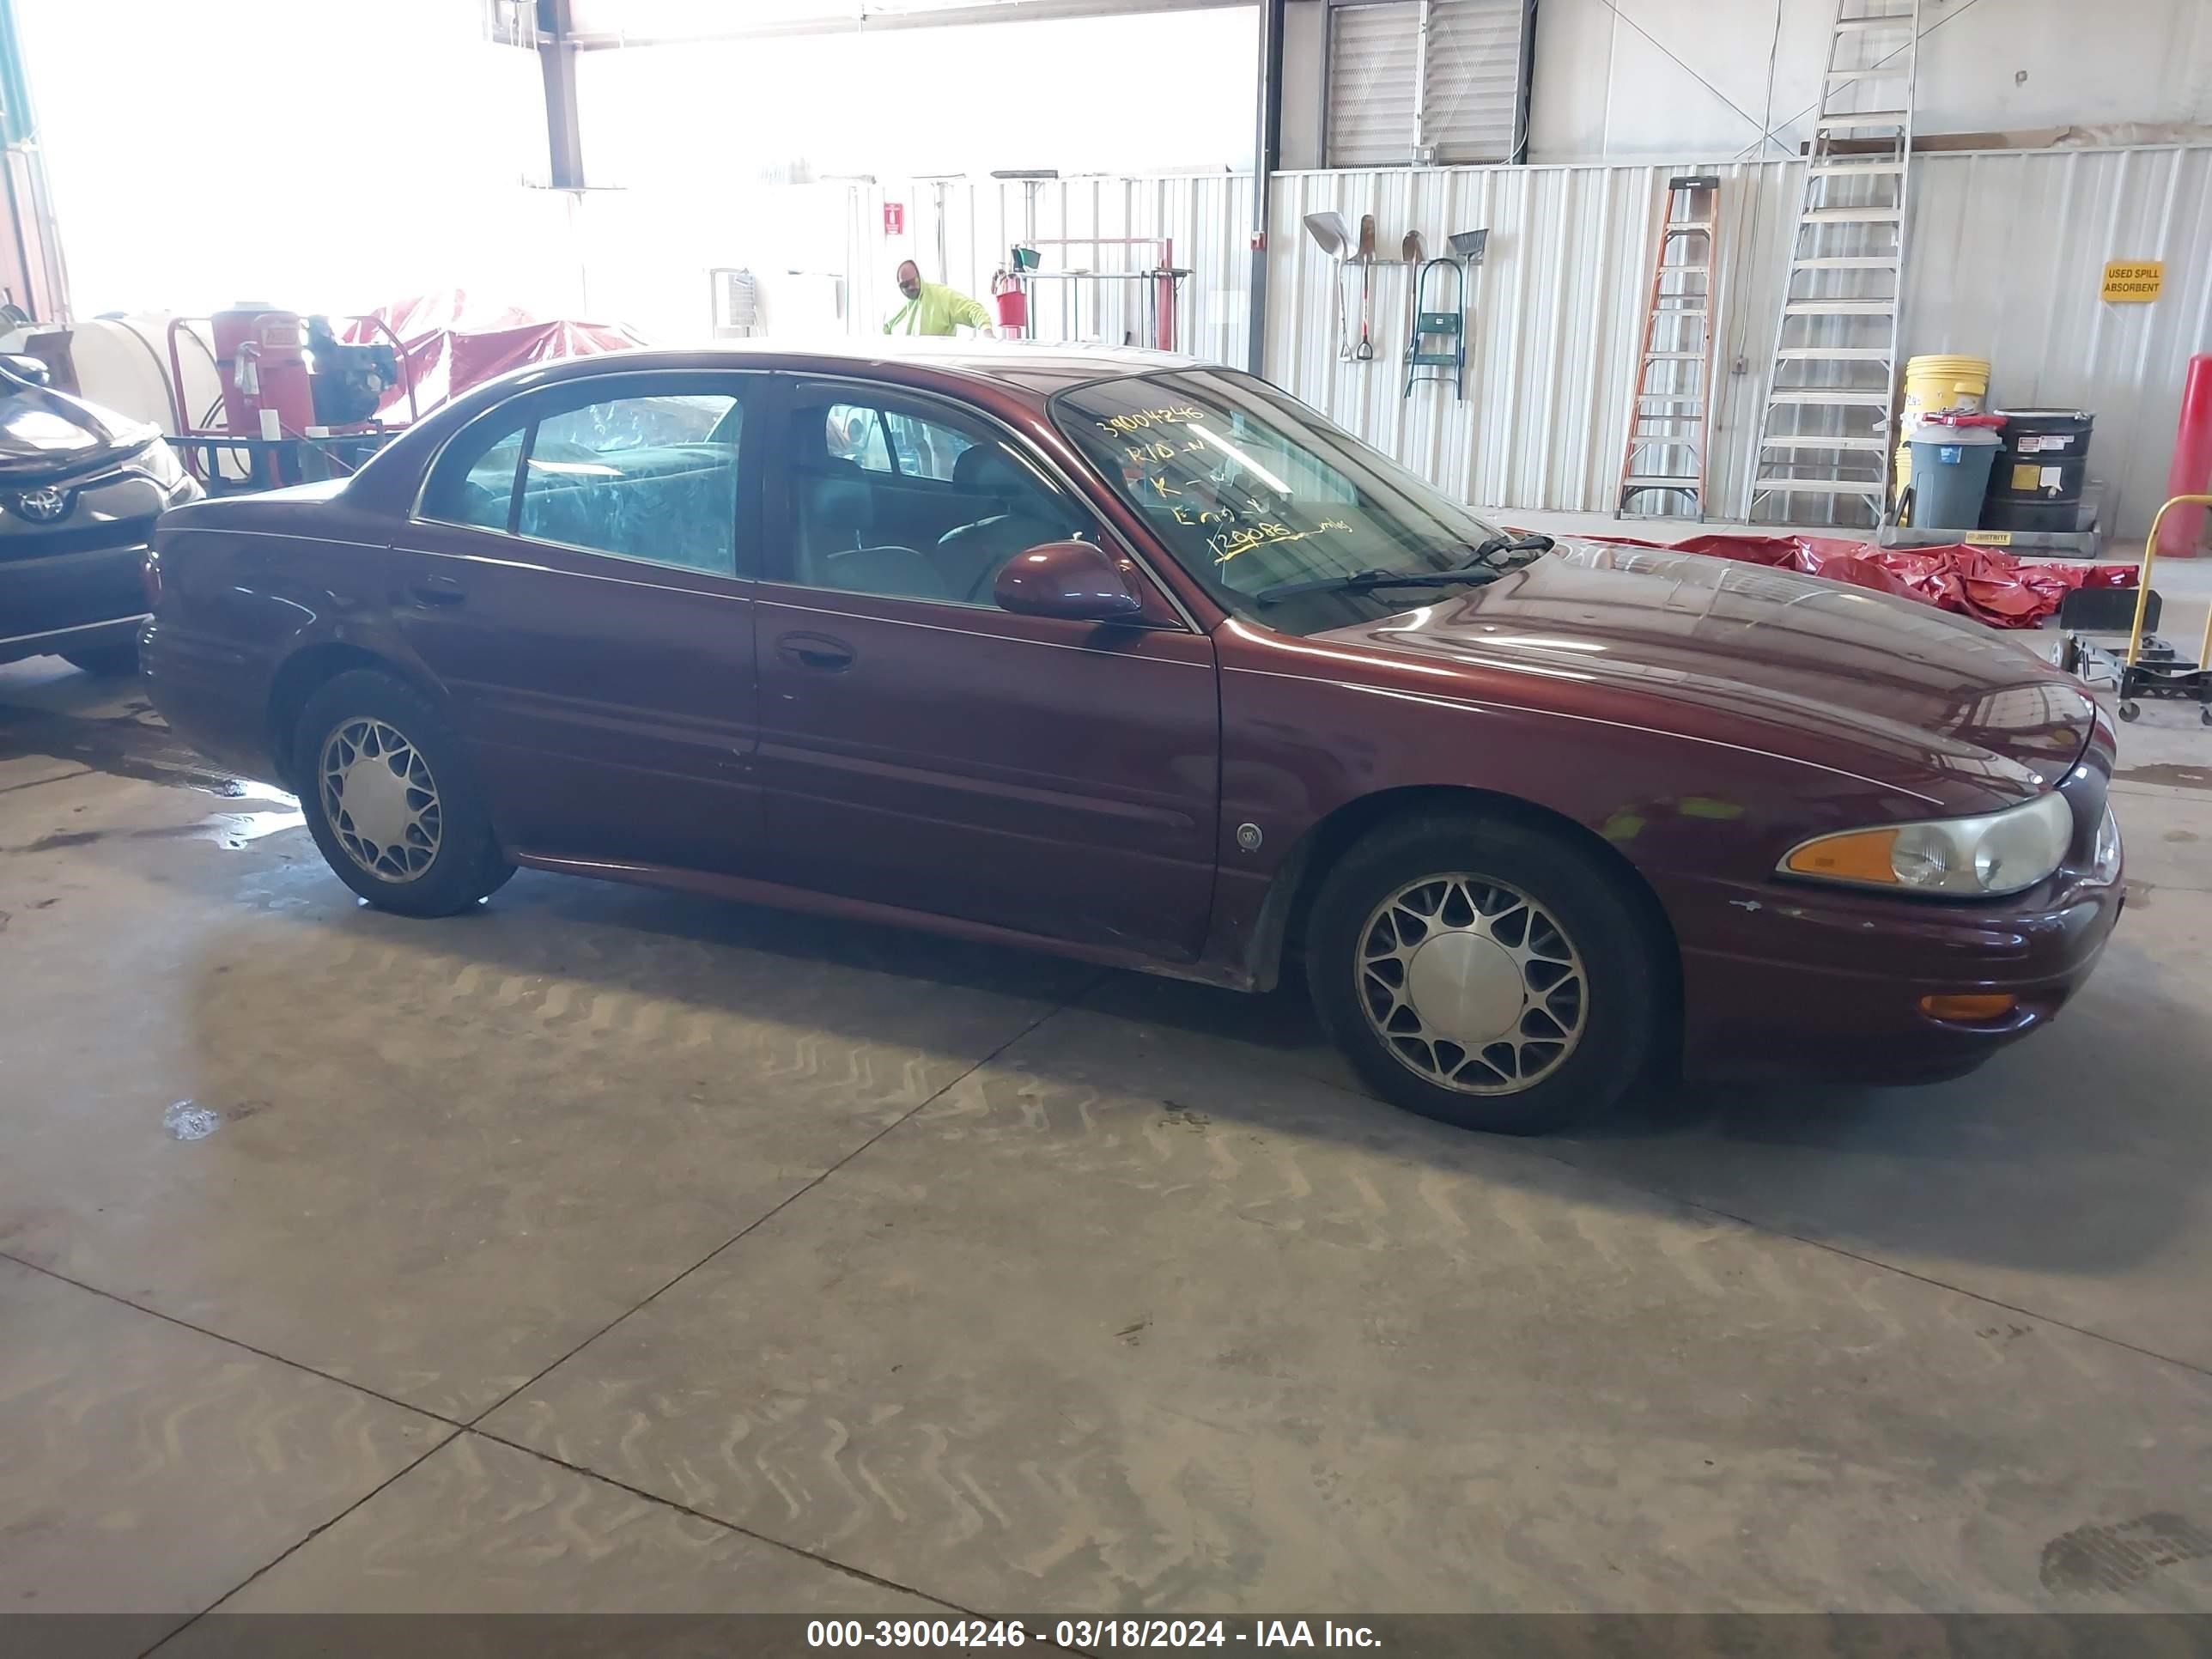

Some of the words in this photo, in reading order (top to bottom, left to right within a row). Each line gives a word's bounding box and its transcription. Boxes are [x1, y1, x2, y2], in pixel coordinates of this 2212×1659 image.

[2109, 269, 2133, 279] USED
[2135, 270, 2160, 279] SPILL
[2105, 283, 2160, 293] ABSORBENT
[1096, 406, 1204, 438] 39004246
[1150, 477, 1182, 499] K
